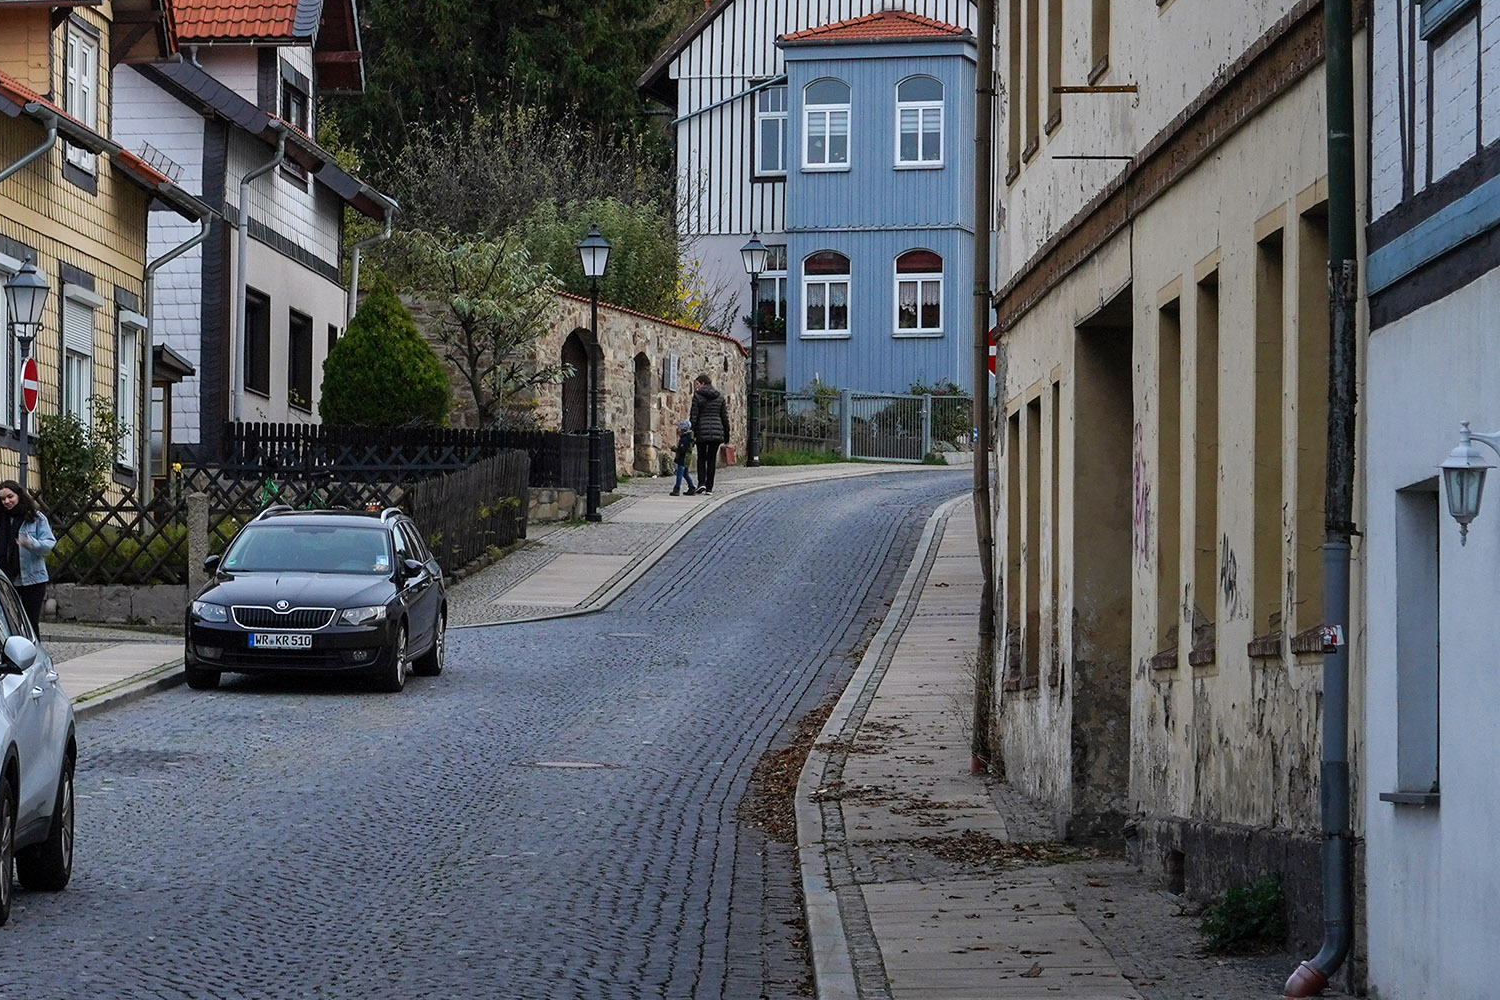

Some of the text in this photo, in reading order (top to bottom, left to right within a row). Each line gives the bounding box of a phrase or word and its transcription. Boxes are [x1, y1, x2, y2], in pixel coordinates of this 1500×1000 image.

[255, 635, 311, 646] WR KR 510
